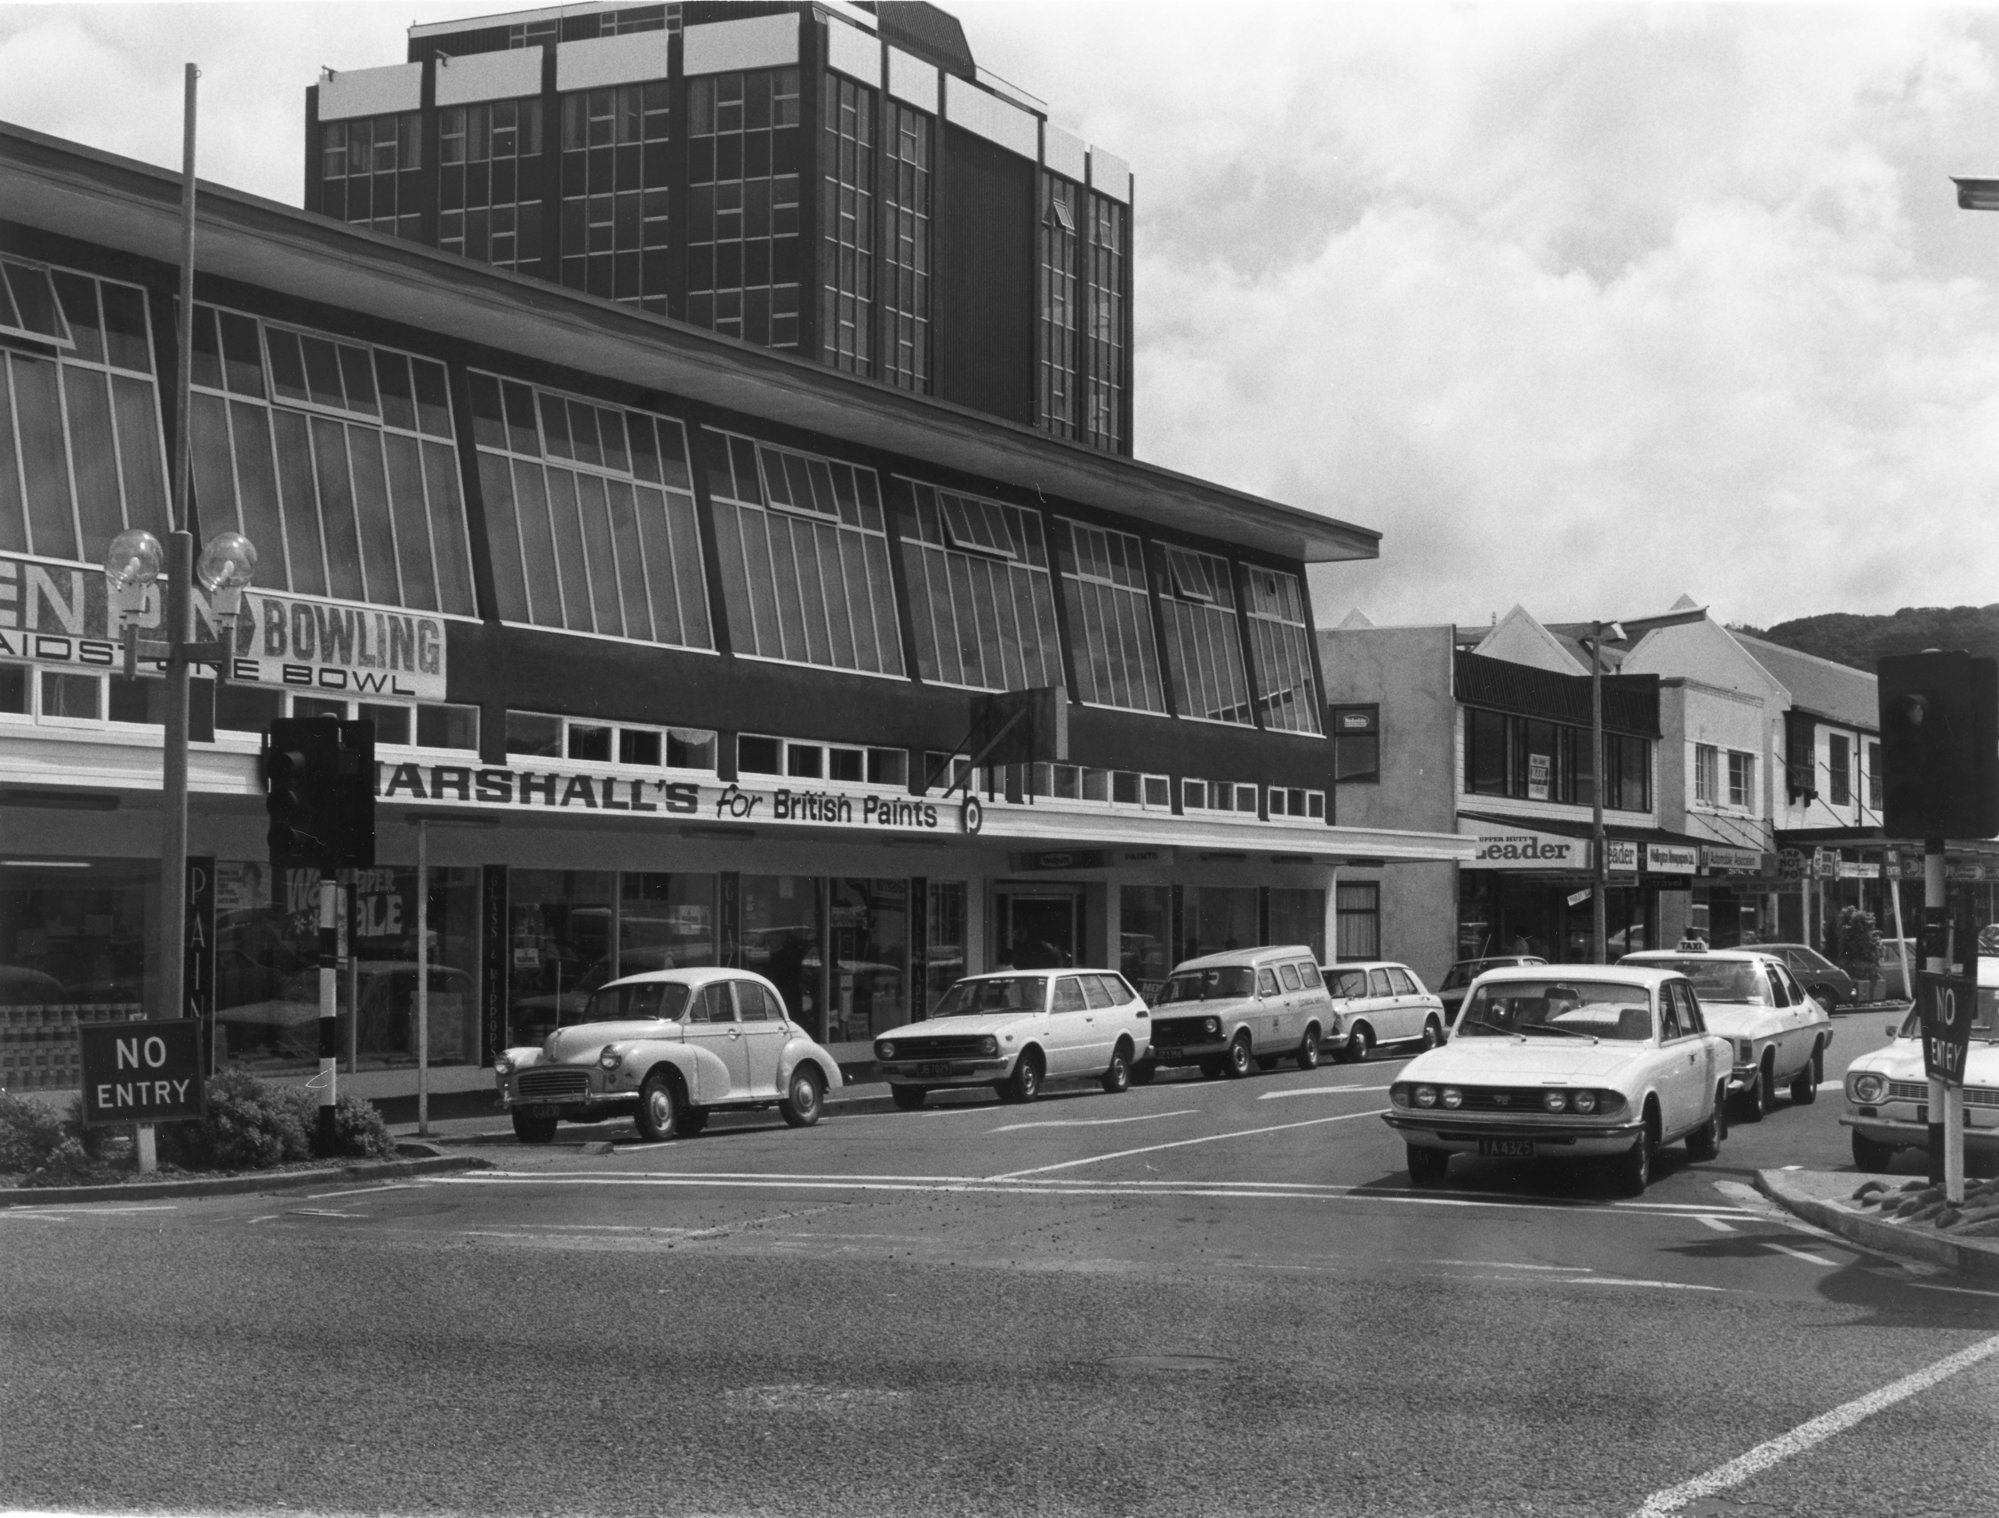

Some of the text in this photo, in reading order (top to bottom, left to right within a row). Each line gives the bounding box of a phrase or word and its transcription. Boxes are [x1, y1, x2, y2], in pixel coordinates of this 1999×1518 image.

[107, 576, 237, 646] PN
[263, 598, 441, 676] BOWLING
[283, 663, 415, 696] BOWL
[376, 762, 938, 829] ARSHALL'S for British Paints
[1680, 942, 1703, 951] TAXI
[1936, 985, 1956, 1025] NO
[116, 1036, 167, 1070] NO
[97, 1079, 190, 1109] ENTRY
